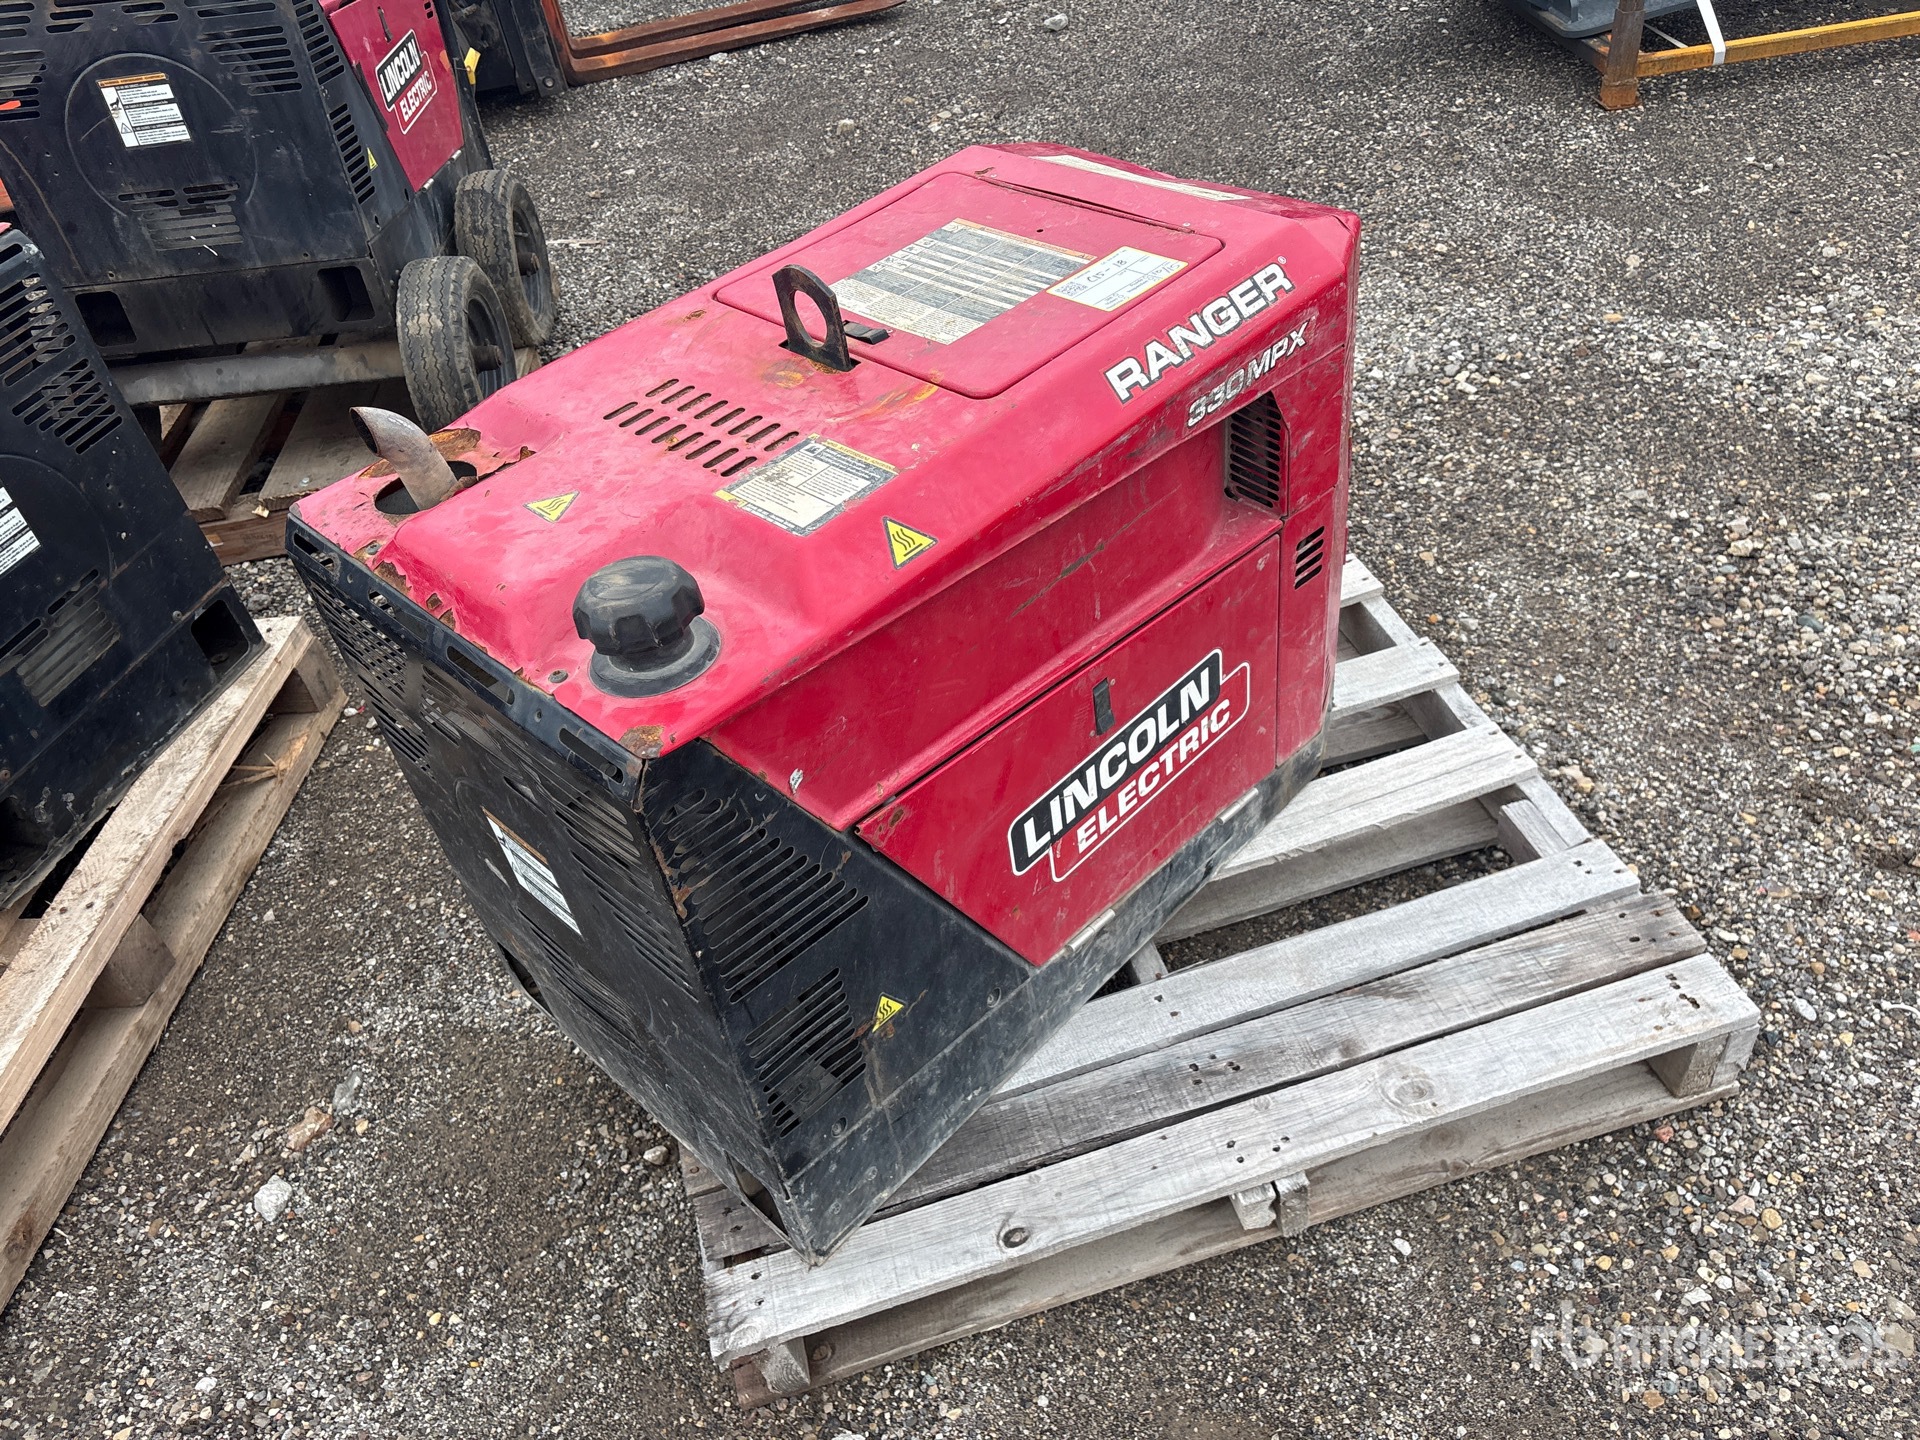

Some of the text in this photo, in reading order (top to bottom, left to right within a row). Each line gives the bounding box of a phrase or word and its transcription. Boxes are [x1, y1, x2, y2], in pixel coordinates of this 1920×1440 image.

[380, 39, 420, 102] LINCOLN
[399, 70, 432, 122] ELECTRIC
[1104, 263, 1294, 401] RANGER
[1023, 667, 1210, 858] LINCOLN
[1077, 698, 1231, 854] ELECTRIC
